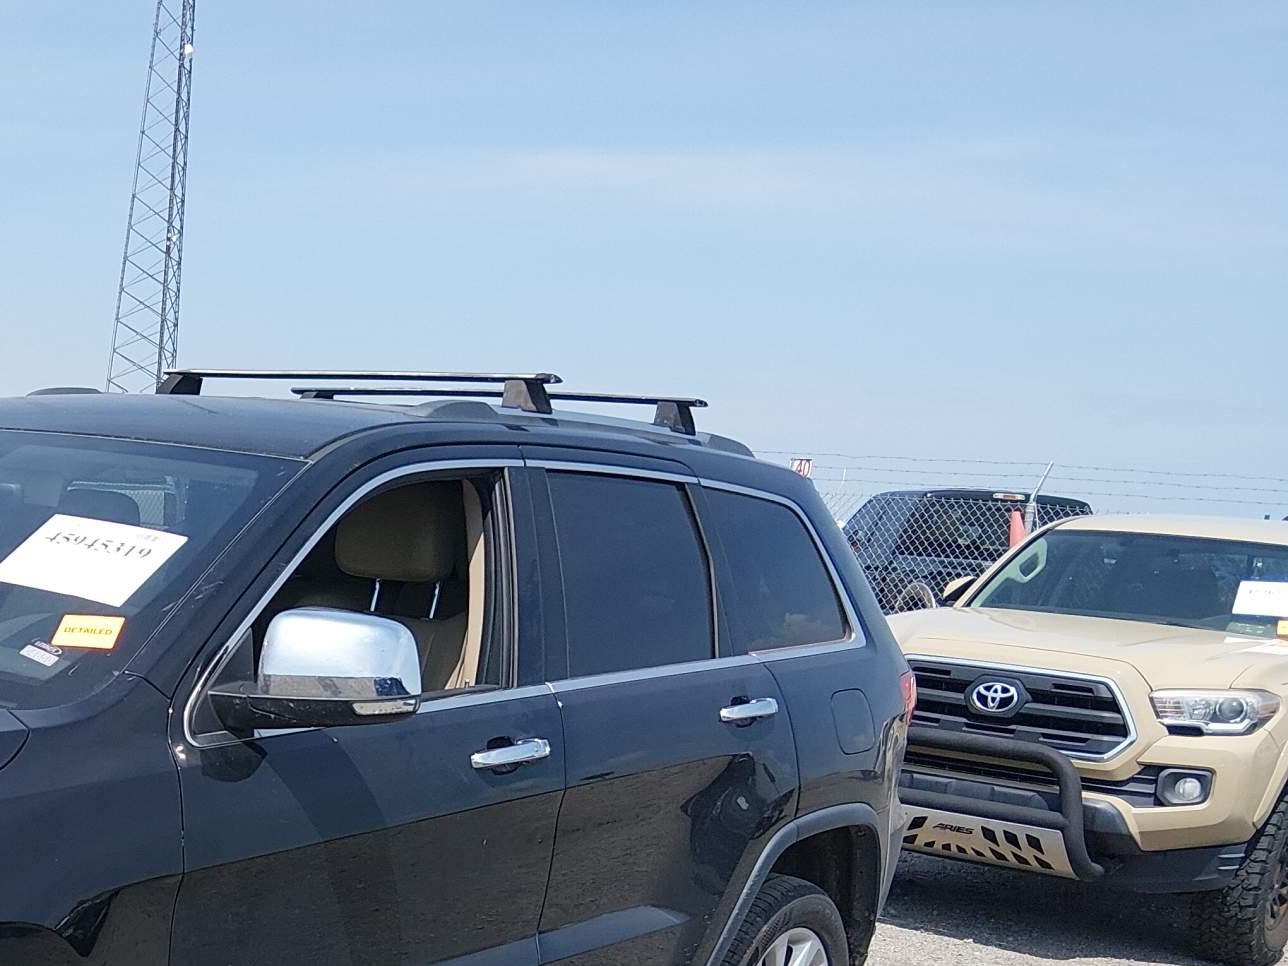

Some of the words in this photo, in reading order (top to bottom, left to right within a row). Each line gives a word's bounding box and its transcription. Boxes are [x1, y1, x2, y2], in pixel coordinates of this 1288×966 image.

[45, 532, 153, 558] 45945319
[63, 626, 113, 636] DETAILED
[932, 822, 975, 835] ARIES
